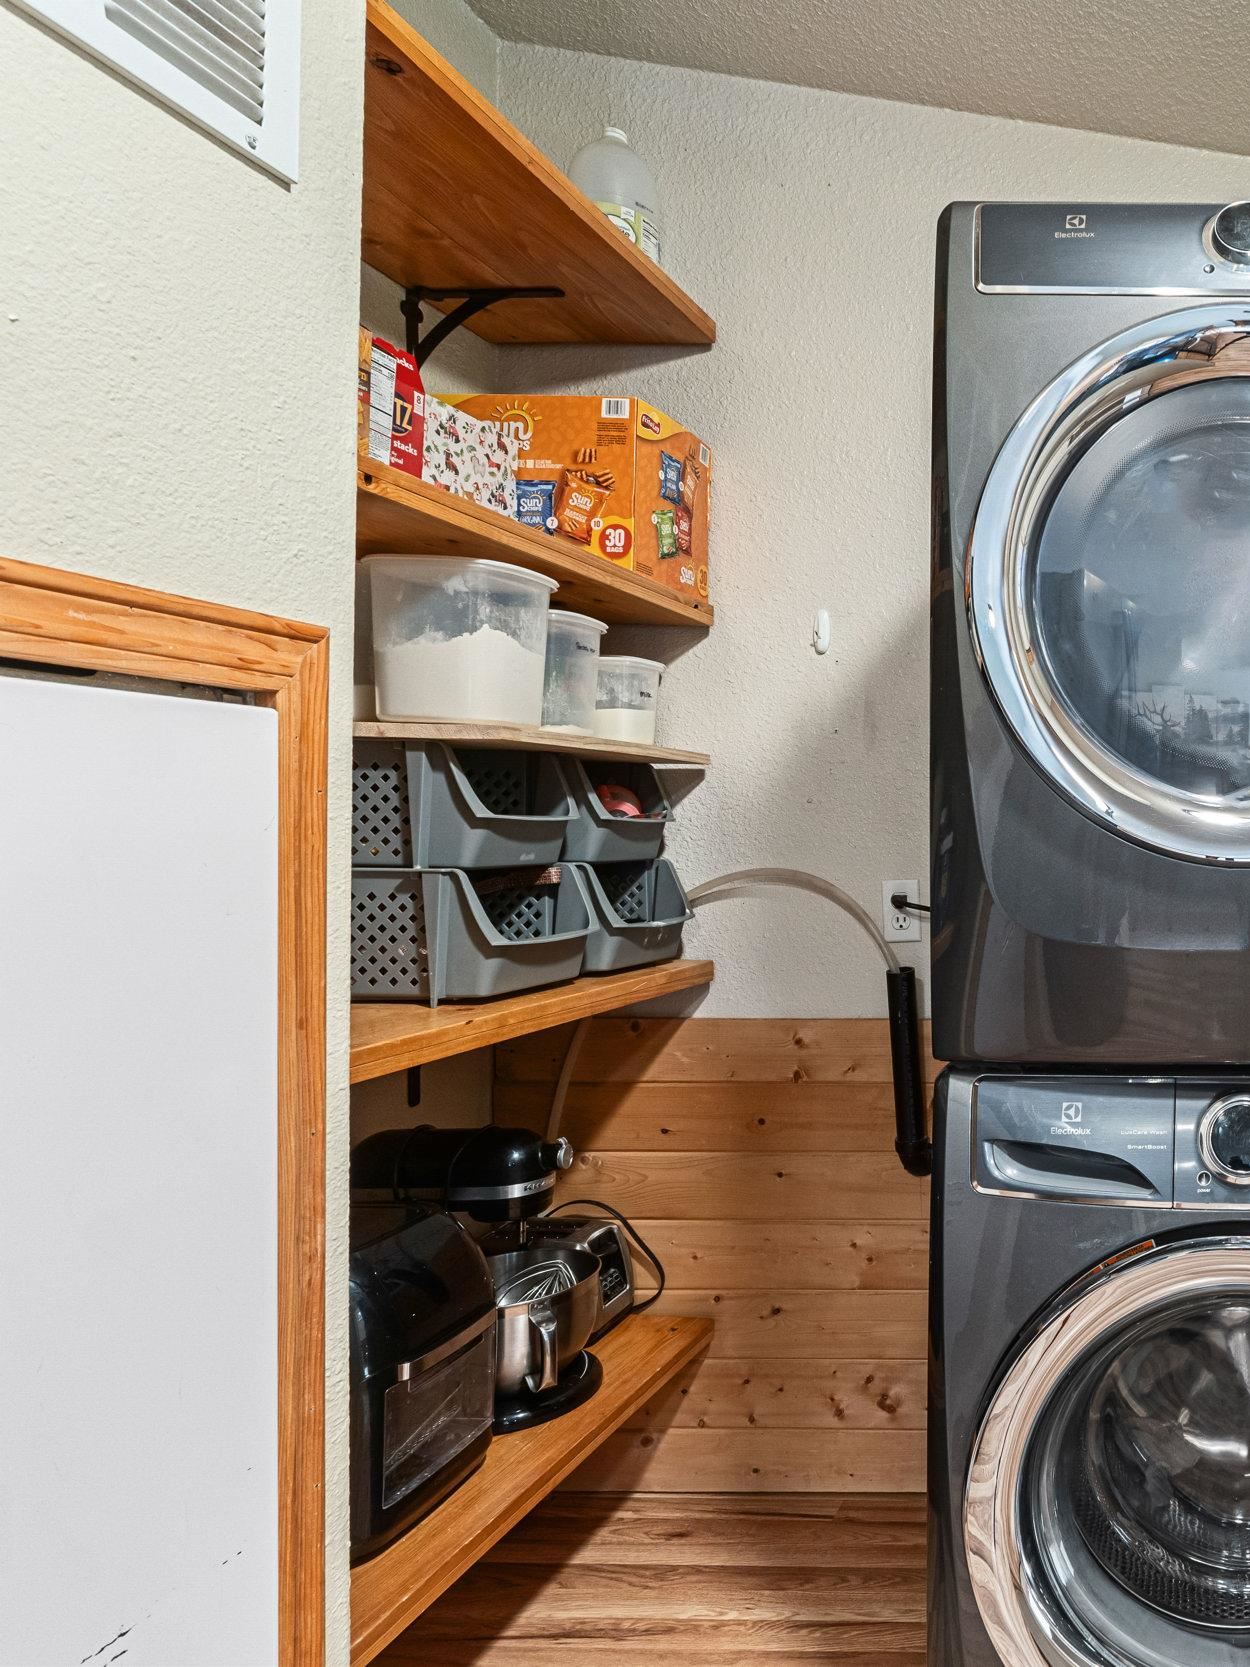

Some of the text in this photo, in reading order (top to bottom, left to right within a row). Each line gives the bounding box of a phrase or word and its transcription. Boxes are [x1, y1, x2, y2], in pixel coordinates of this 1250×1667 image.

[416, 395, 421, 405] 8
[393, 440, 418, 456] stacks
[520, 498, 542, 512] Sun
[569, 492, 594, 508] Sun
[593, 520, 601, 528] 10
[605, 528, 625, 547] 30
[1050, 1127, 1091, 1135] Electrolux
